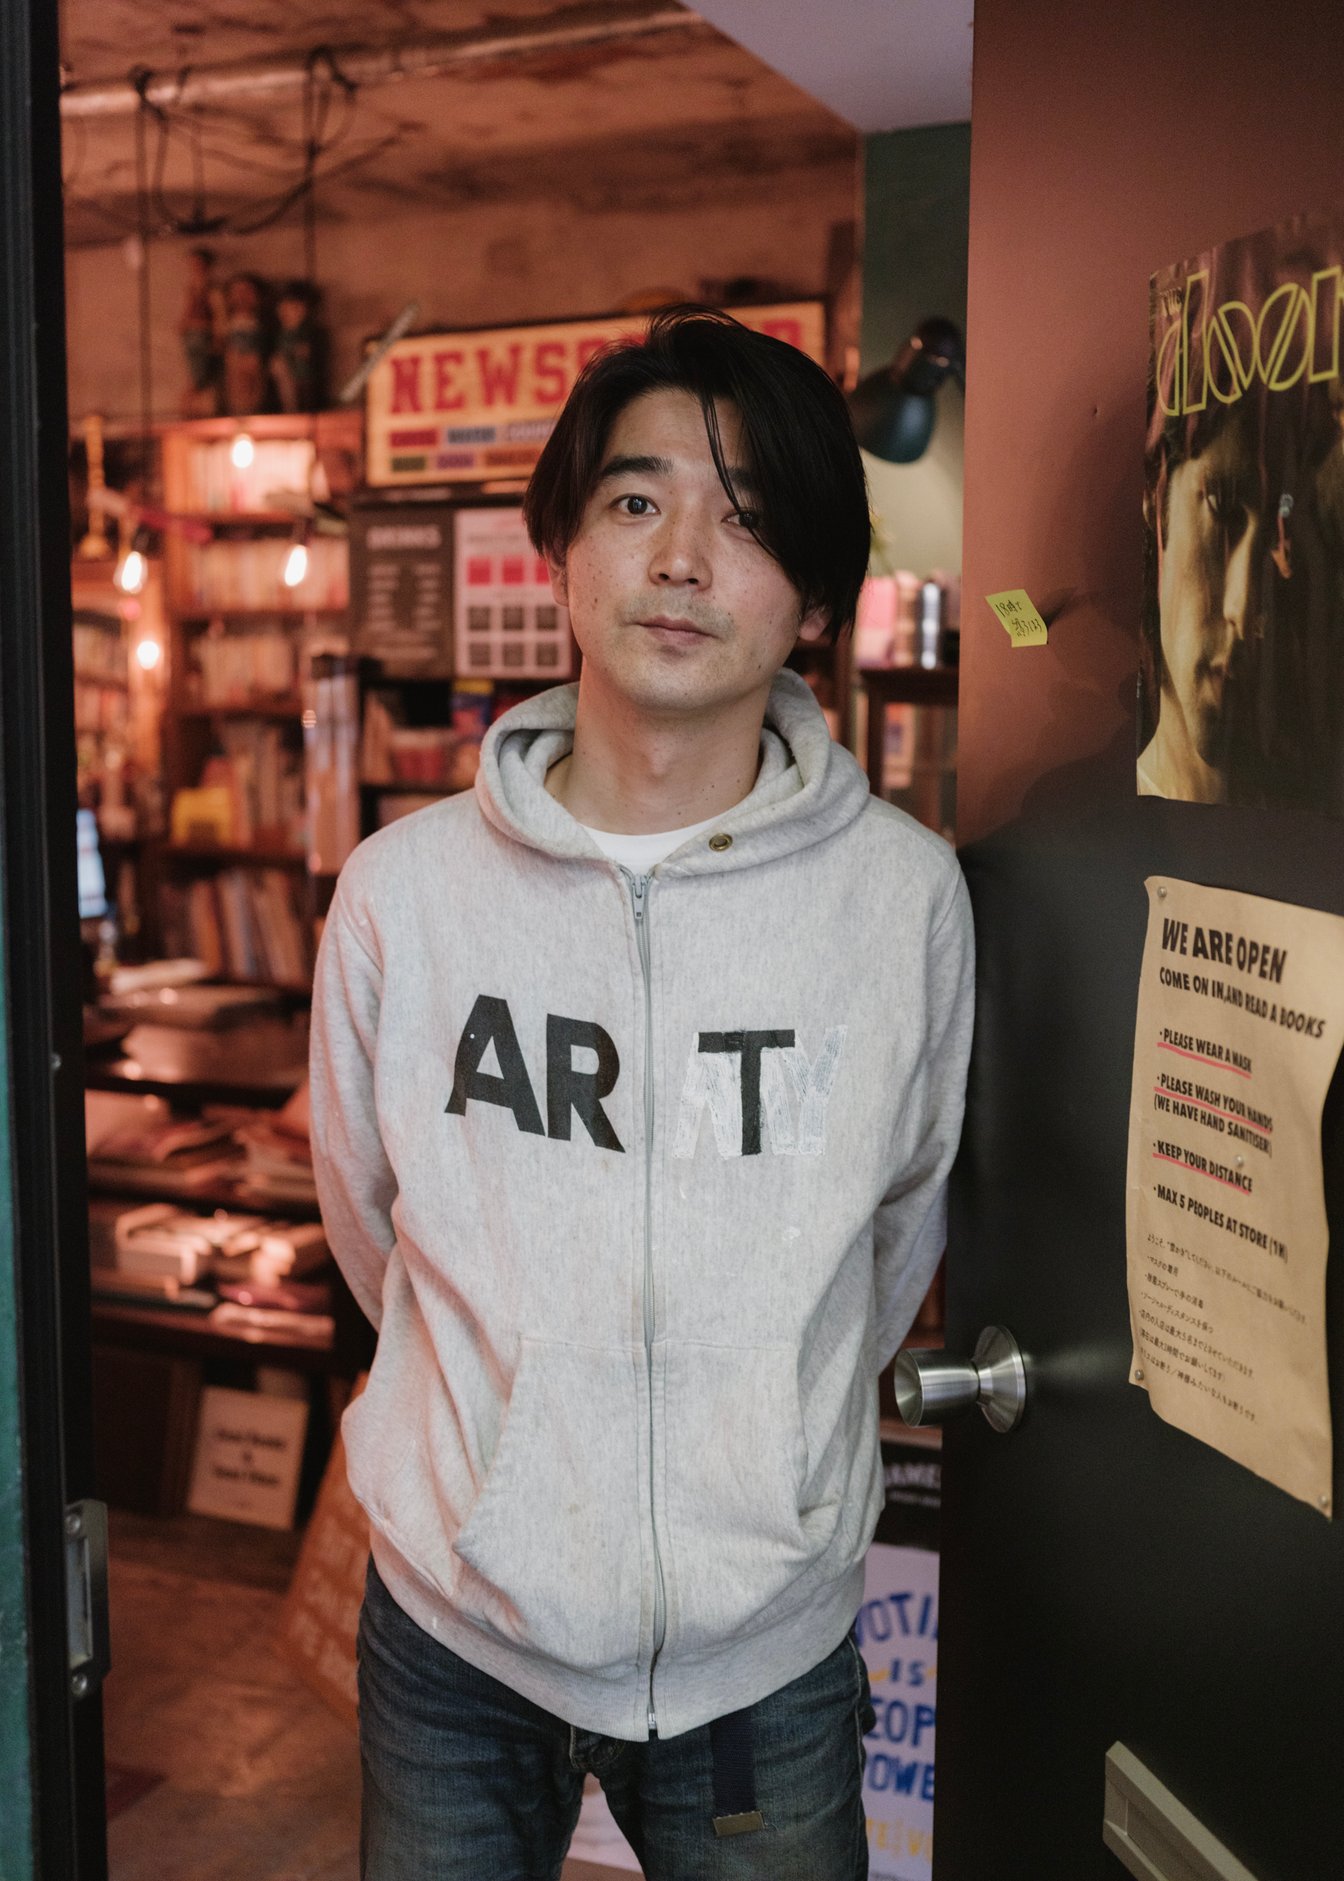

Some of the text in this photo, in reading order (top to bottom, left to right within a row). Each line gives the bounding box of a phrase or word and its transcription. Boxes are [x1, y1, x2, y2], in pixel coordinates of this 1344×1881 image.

[1162, 918, 1287, 985] WE ARE OPEN
[1160, 966, 1191, 992] COME
[1193, 975, 1209, 997] ON
[1245, 993, 1269, 1020] READ
[1270, 1004, 1278, 1024] A
[1279, 1006, 1327, 1040] BOOKS
[1163, 1028, 1253, 1074] PLEASE WEAR A MASK
[1154, 1093, 1274, 1159] (WE HAVE HAND SANITISER)
[1161, 1073, 1273, 1133] PLEASE WASH YOUR HANDS
[1157, 1140, 1253, 1193] KEEP YOUR DISTANCE
[1157, 1183, 1178, 1206] MAX
[1179, 1194, 1186, 1209] 5
[1187, 1197, 1225, 1228] PEOPLES
[1226, 1216, 1238, 1234] AT
[1239, 1223, 1268, 1250] STORE
[889, 1657, 926, 1688] IS
